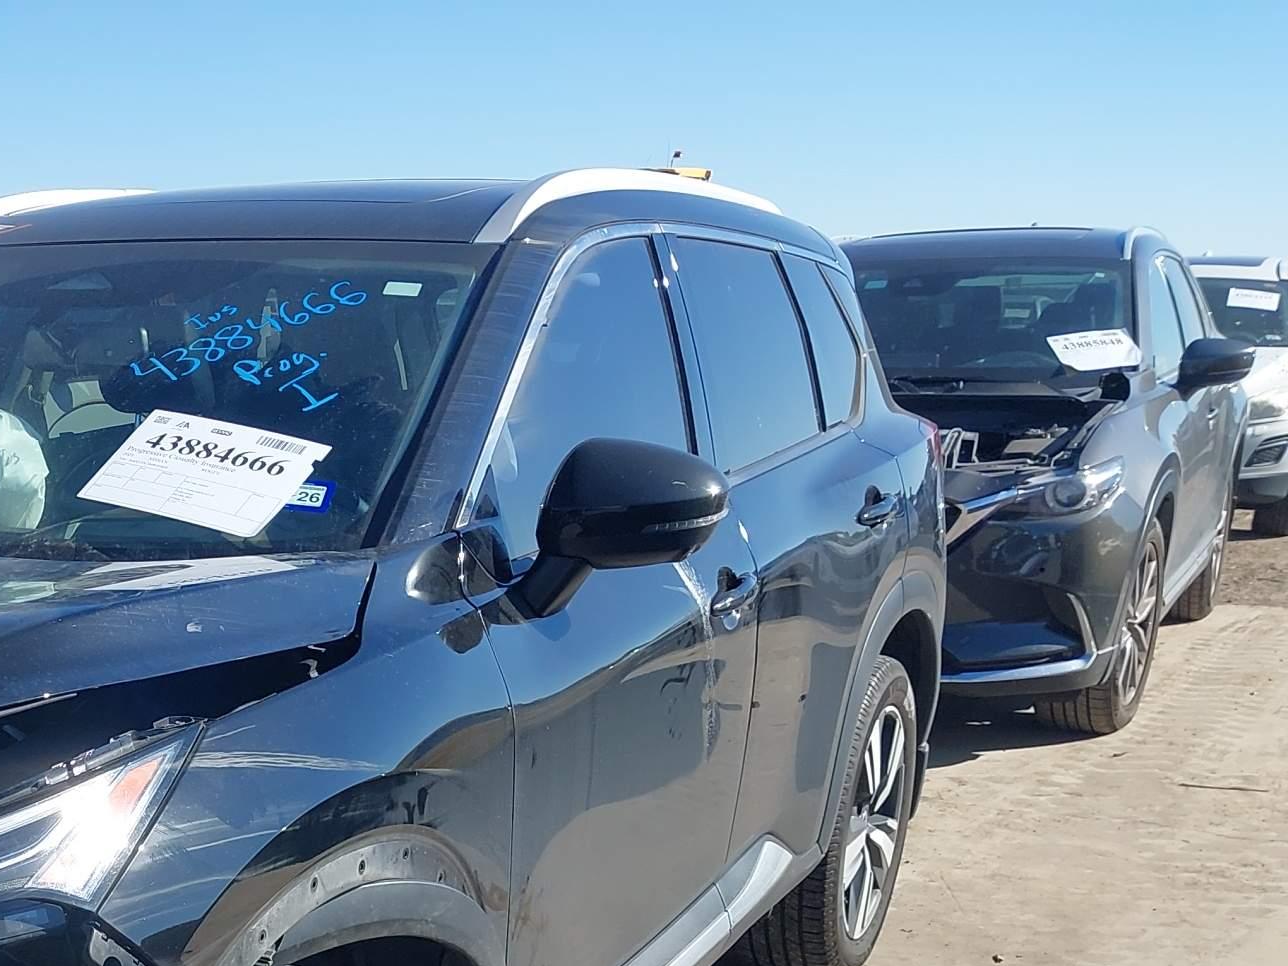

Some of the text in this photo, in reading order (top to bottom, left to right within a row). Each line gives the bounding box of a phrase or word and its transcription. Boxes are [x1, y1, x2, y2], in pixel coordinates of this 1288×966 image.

[129, 280, 368, 381] 43884666
[127, 445, 168, 458] Progressive
[145, 432, 290, 477] 43884666
